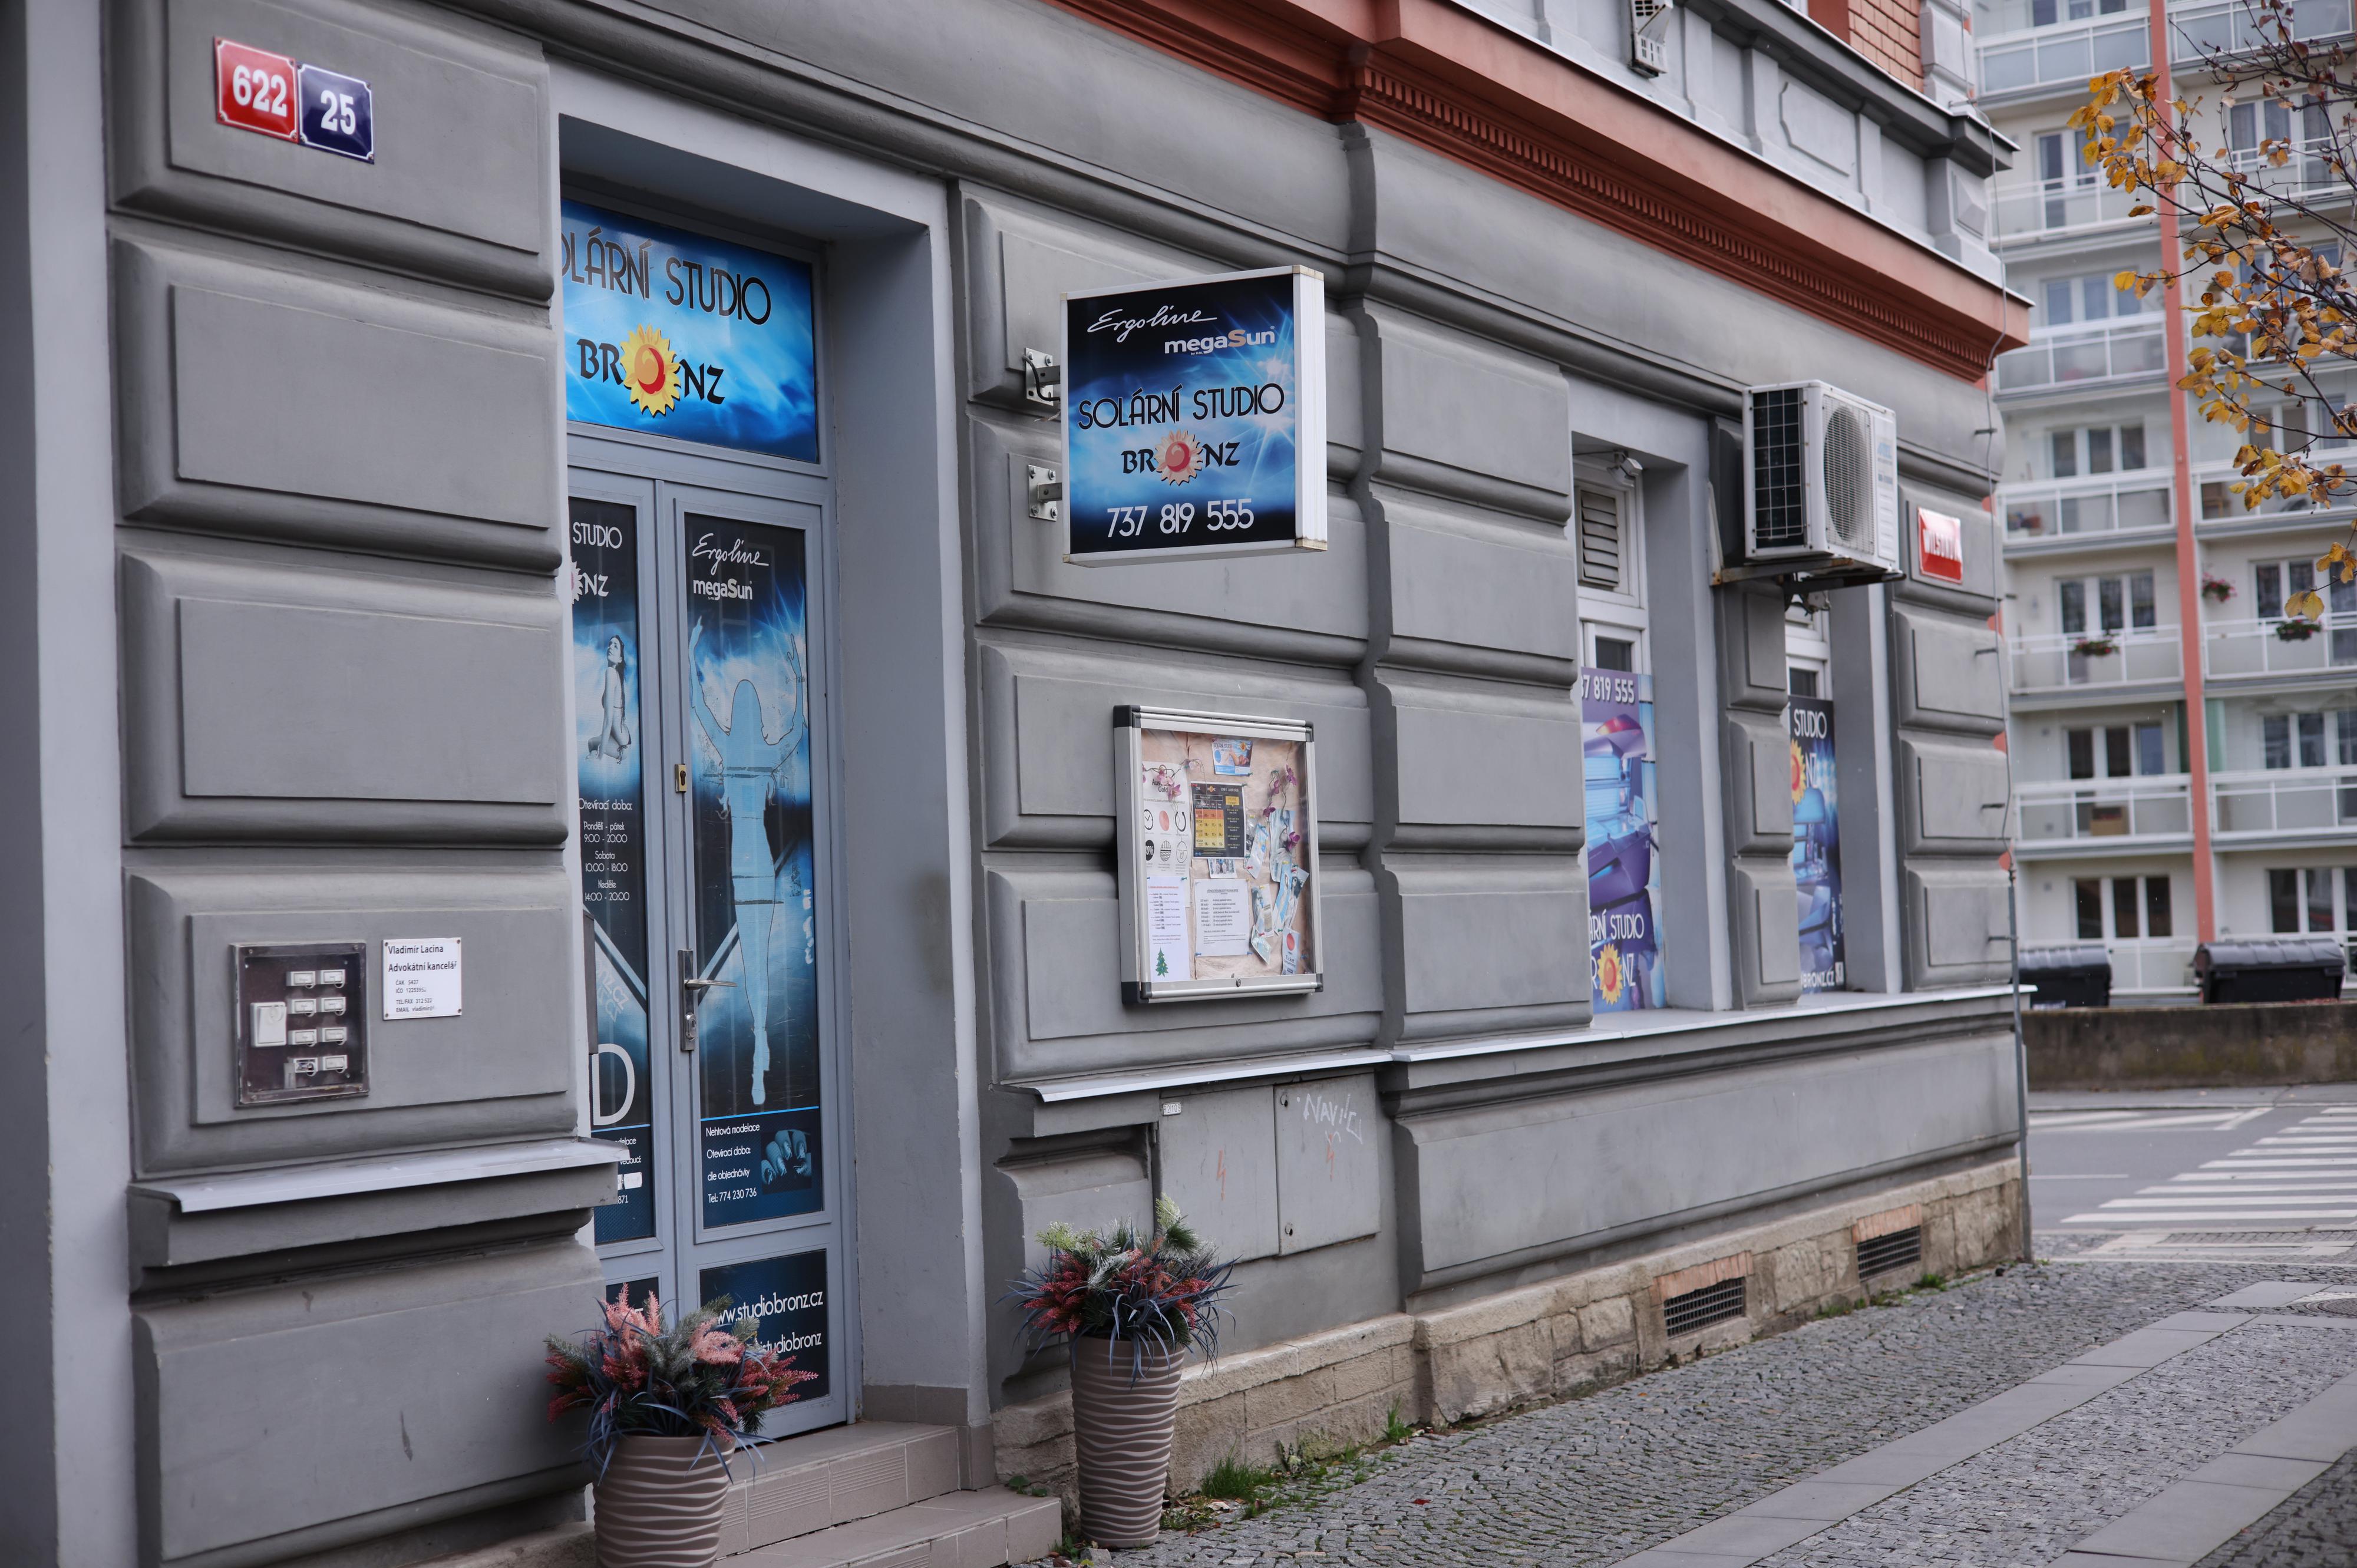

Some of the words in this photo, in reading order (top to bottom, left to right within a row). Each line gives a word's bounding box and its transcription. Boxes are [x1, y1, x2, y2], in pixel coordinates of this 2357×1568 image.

[233, 65, 288, 117] 622
[321, 90, 356, 135] 25
[561, 226, 653, 302] LÁRNÍ
[665, 256, 771, 325] STUDIO
[1087, 305, 1217, 343] Ergoline
[1078, 384, 1183, 430] SOLÁRNÍ
[1193, 383, 1285, 421] STUDIO
[1108, 505, 1148, 537] 737
[1160, 503, 1194, 534] 819
[1207, 498, 1254, 530] 555
[573, 521, 622, 549] STUDIO
[692, 533, 769, 575] Ergoline
[1593, 676, 1611, 701] 819
[1615, 678, 1635, 704] 555
[1794, 709, 1827, 739] STUDIO
[610, 822, 625, 833] pátek
[584, 834, 600, 843] 9:00
[607, 834, 628, 843] 20:00
[595, 851, 615, 859] Sobota
[585, 863, 604, 872] 10:00
[611, 863, 628, 872] 18:00
[598, 879, 616, 889] Neděle
[585, 892, 602, 901] 14:00
[609, 892, 629, 901] 20:00
[1610, 913, 1644, 940] STUDIO
[421, 945, 444, 953] Lacina
[388, 962, 425, 972] Advokátní
[706, 1127, 731, 1137] Nehtová
[732, 1123, 760, 1134] modelace
[707, 1147, 732, 1159] Otevírací
[734, 1146, 751, 1156] doba:
[707, 1172, 717, 1181] dle
[718, 1168, 750, 1180] objednávky
[618, 1195, 629, 1204] 871
[719, 1191, 731, 1201] 774
[732, 1189, 744, 1200] 230
[745, 1187, 757, 1197] 736
